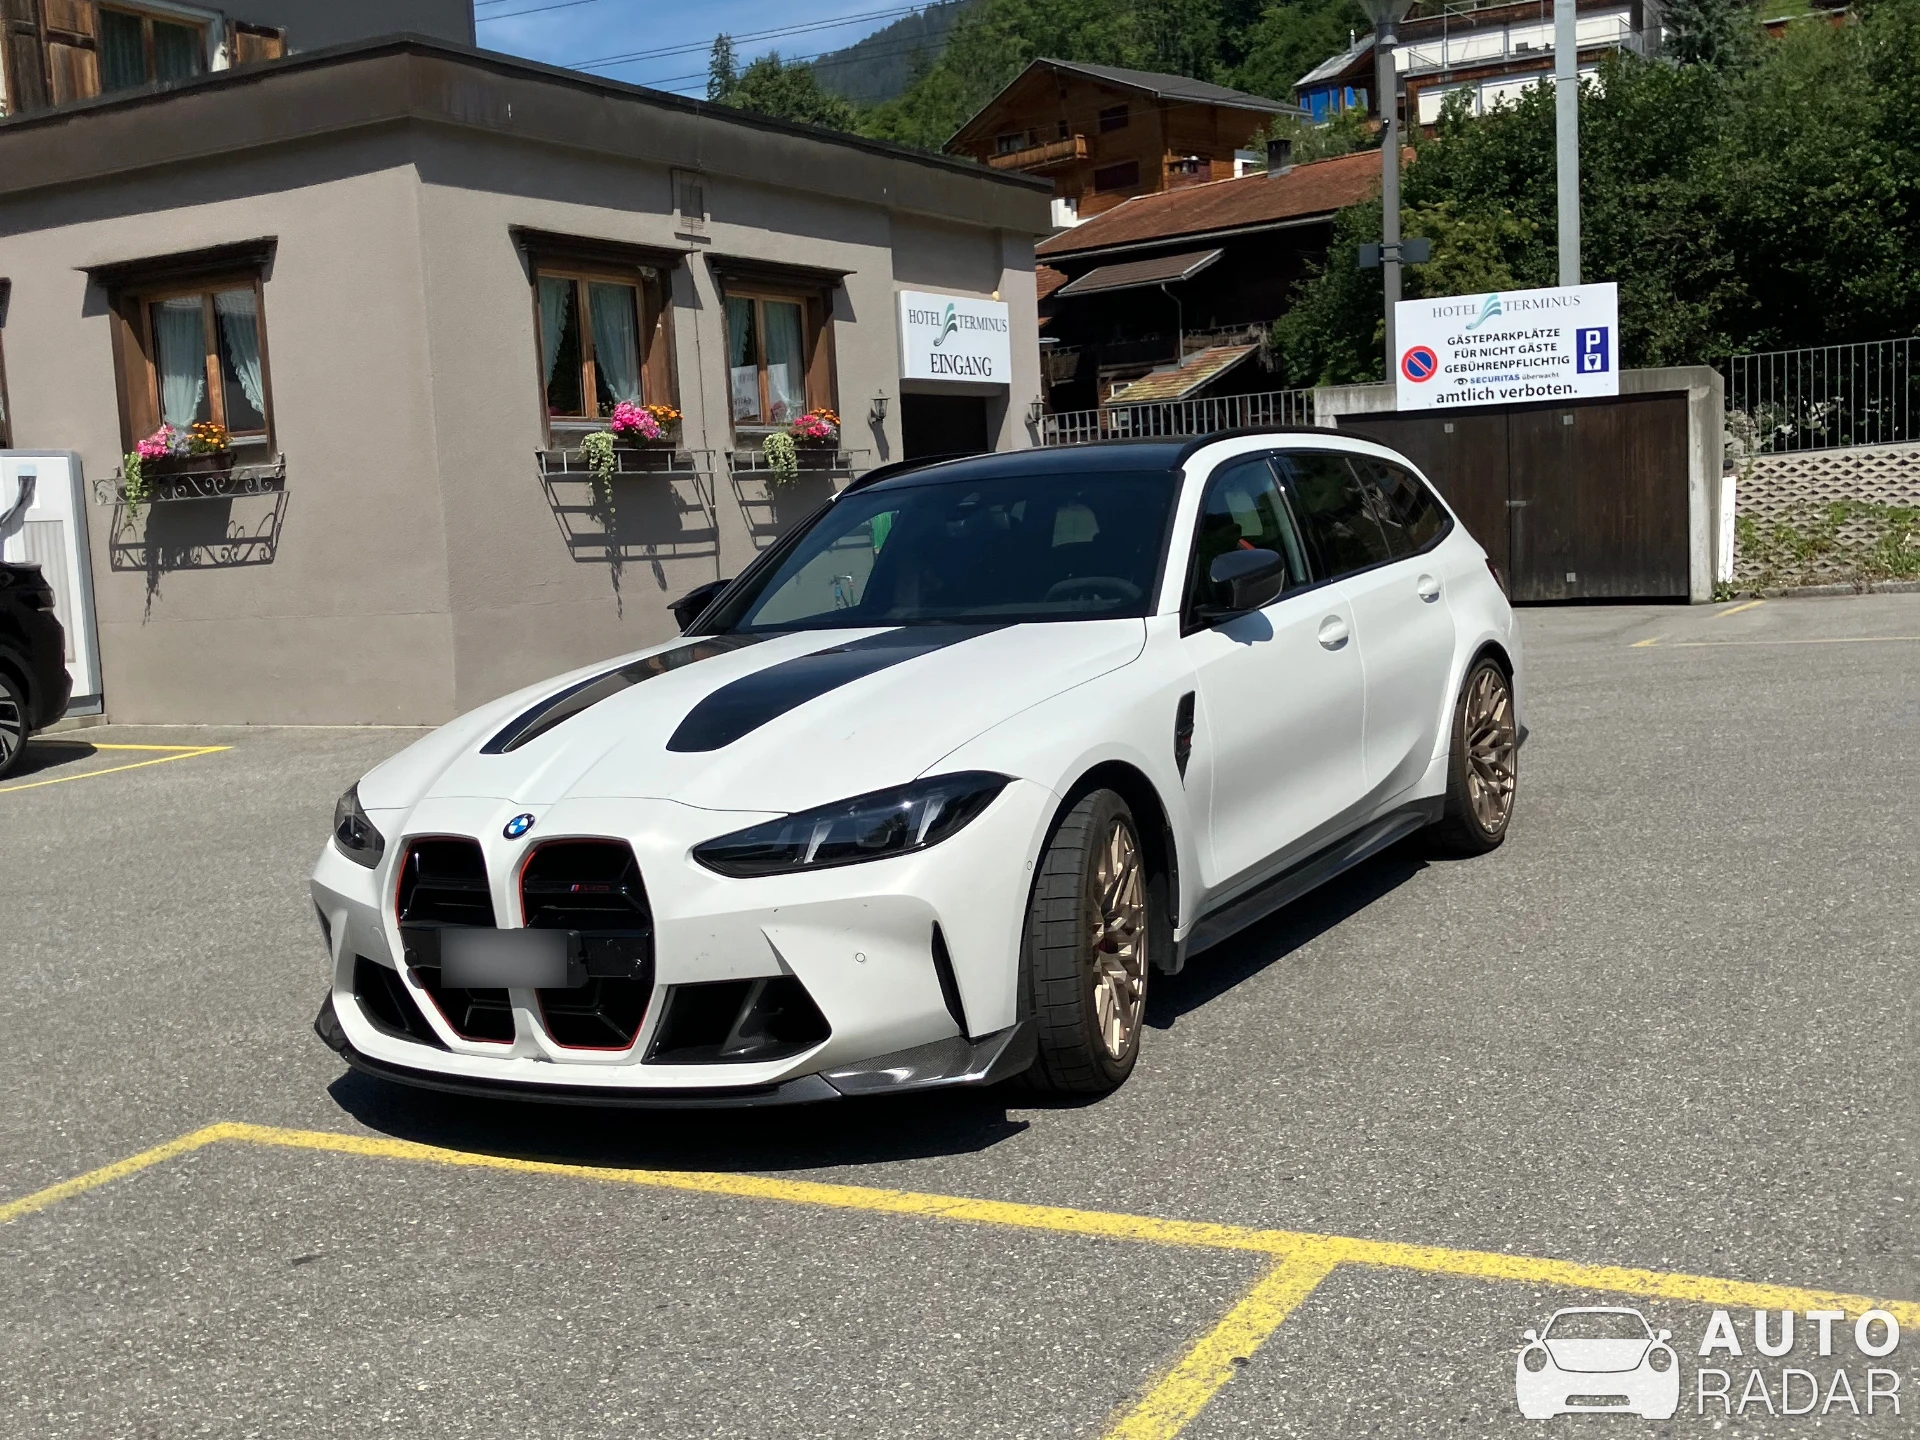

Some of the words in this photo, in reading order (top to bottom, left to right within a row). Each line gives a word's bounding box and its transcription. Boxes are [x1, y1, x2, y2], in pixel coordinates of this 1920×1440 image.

[1432, 304, 1479, 319] HOTEL
[1503, 294, 1581, 312] TERMINUS
[908, 309, 942, 326] HOTEL
[958, 314, 1008, 332] TERMINUS
[1447, 328, 1561, 346] GÄSTEPARKPLÄTZE
[1585, 330, 1601, 353] P
[1454, 346, 1477, 359] FÜR
[1479, 345, 1516, 358] NICHT
[1518, 341, 1558, 355] GÄSTE
[930, 353, 992, 376] EINGANG
[1444, 354, 1570, 374] GEBÜHRENPFLICHTIG
[1469, 373, 1521, 384] SECURITAS
[1522, 371, 1560, 381] überwacht
[1436, 384, 1495, 404] amtlich
[1499, 382, 1579, 400] verboten.
